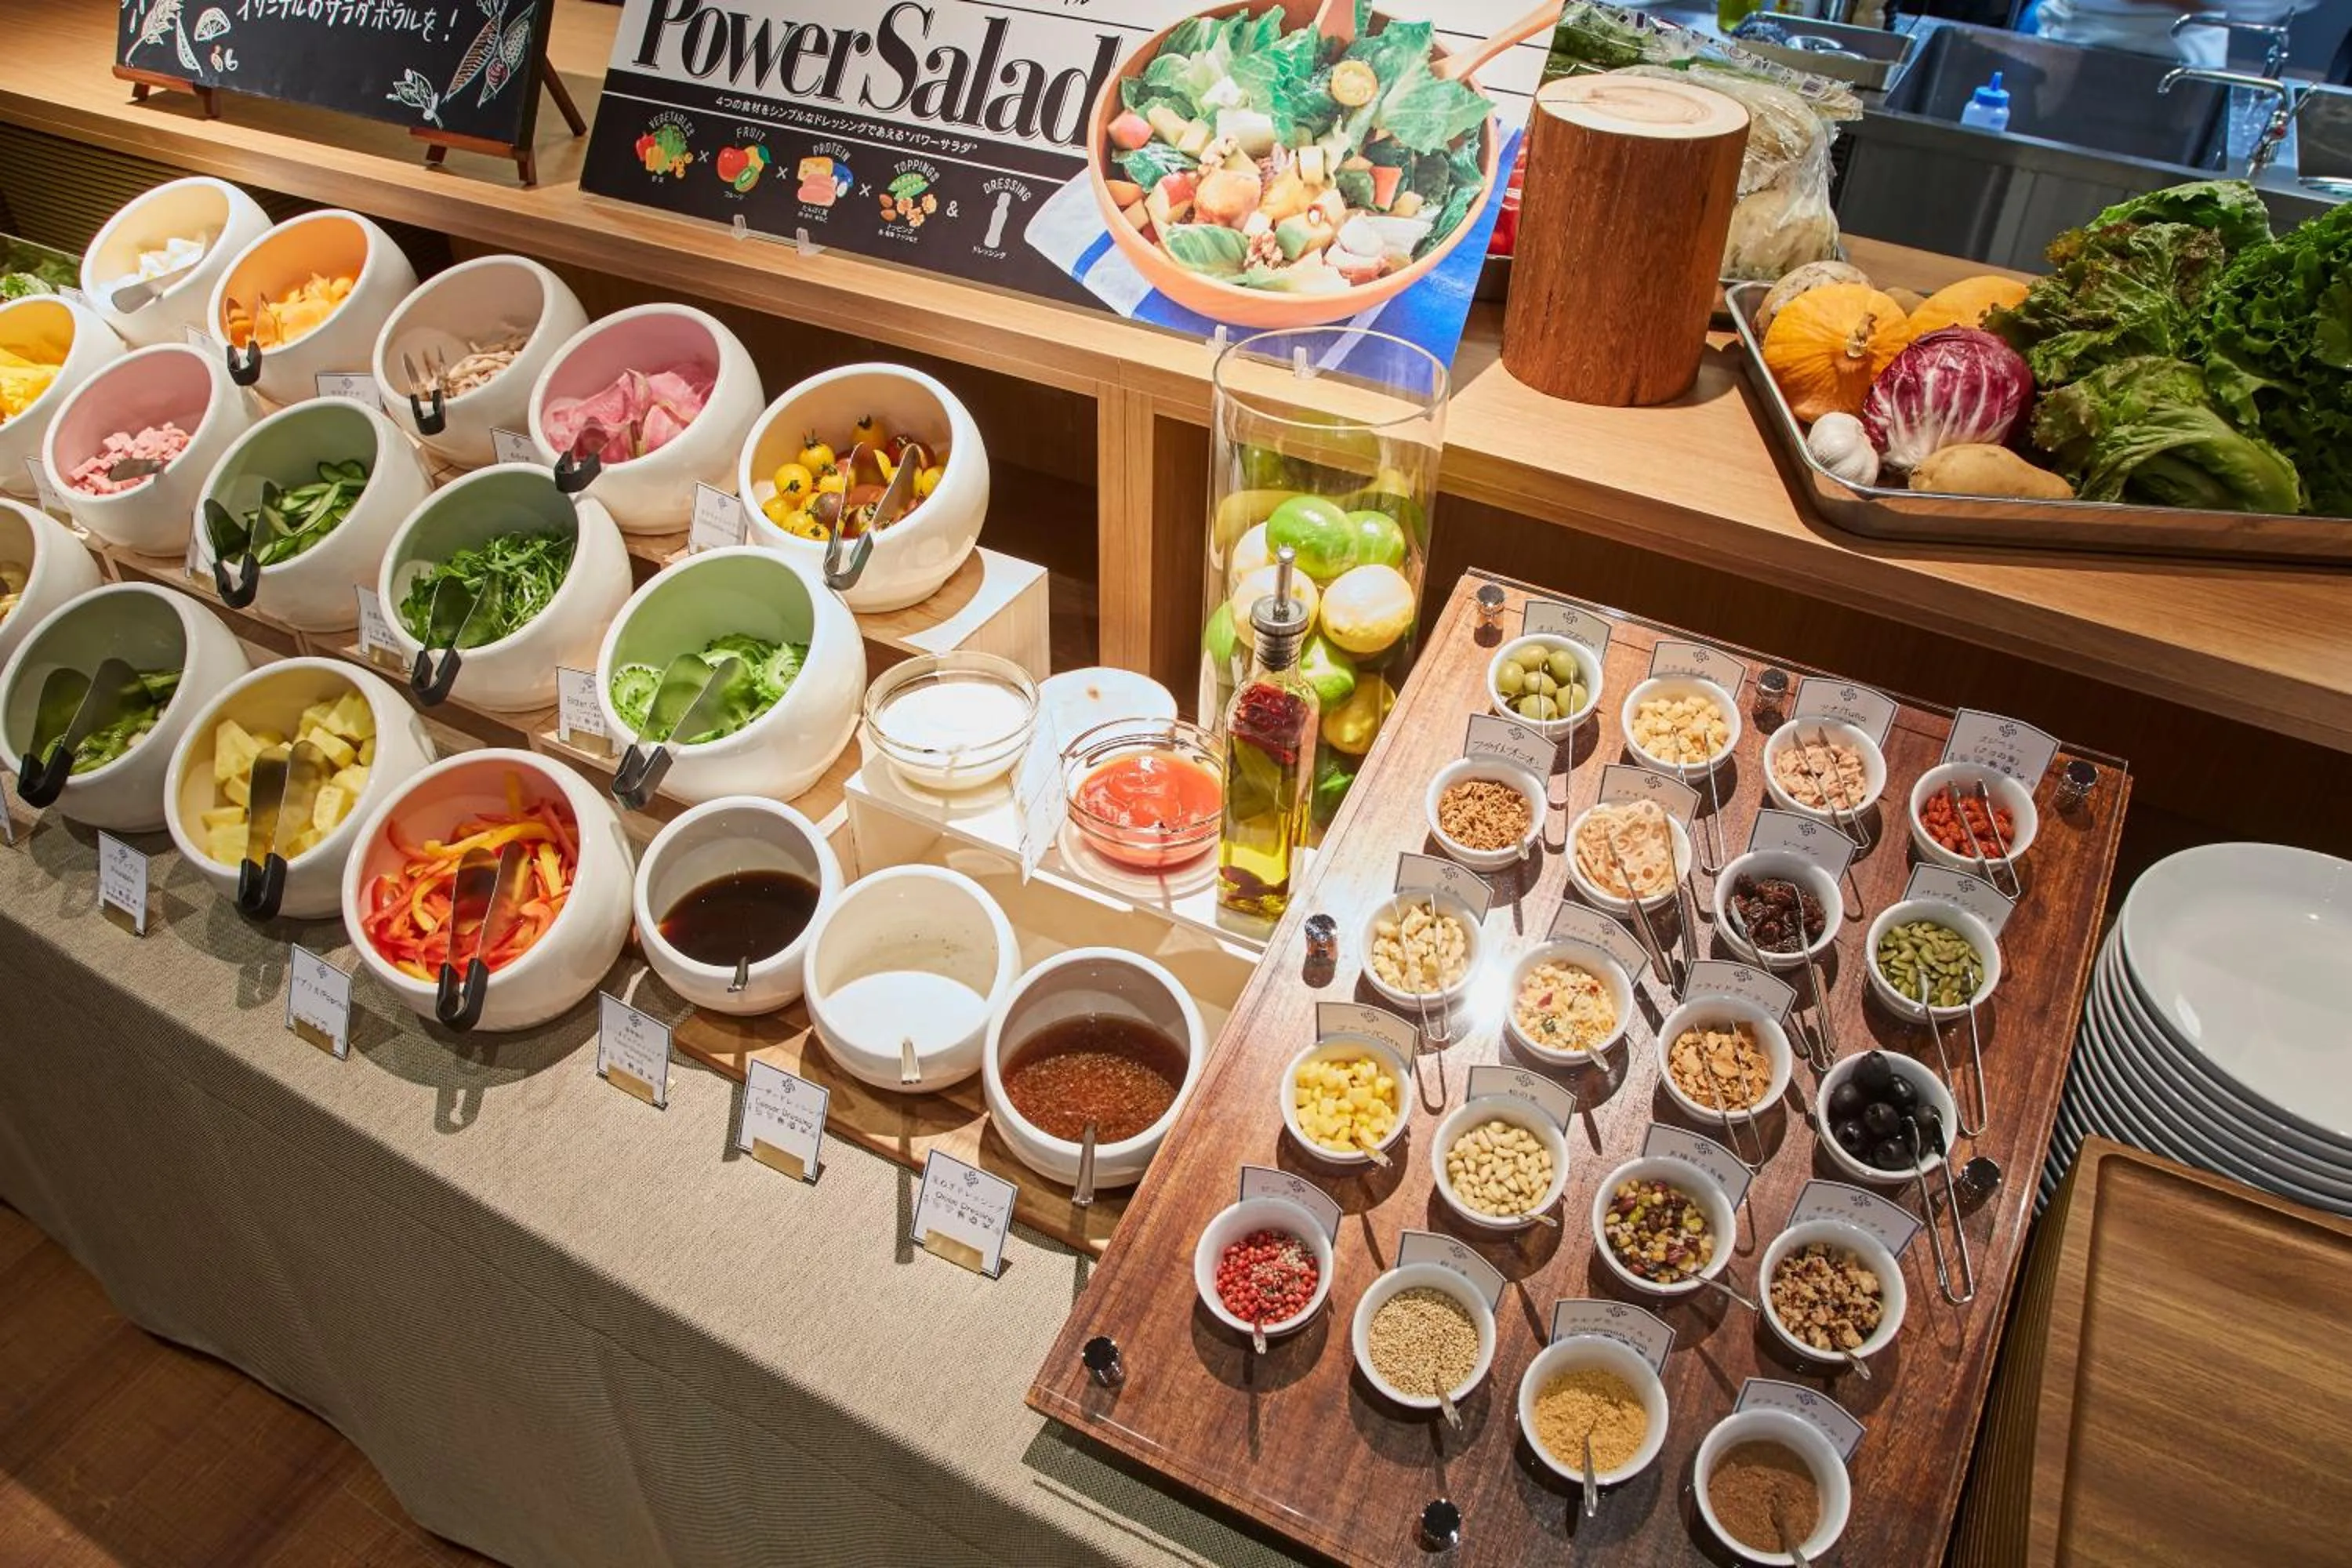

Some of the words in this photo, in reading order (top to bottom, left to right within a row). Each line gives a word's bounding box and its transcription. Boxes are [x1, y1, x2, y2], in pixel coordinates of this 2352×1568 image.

[648, 111, 695, 137] VEGETABLES
[736, 126, 767, 143] FRUIT
[812, 142, 852, 162] PROTEIN
[894, 159, 940, 183] TOPPINGS
[982, 178, 1032, 202] DRESSING
